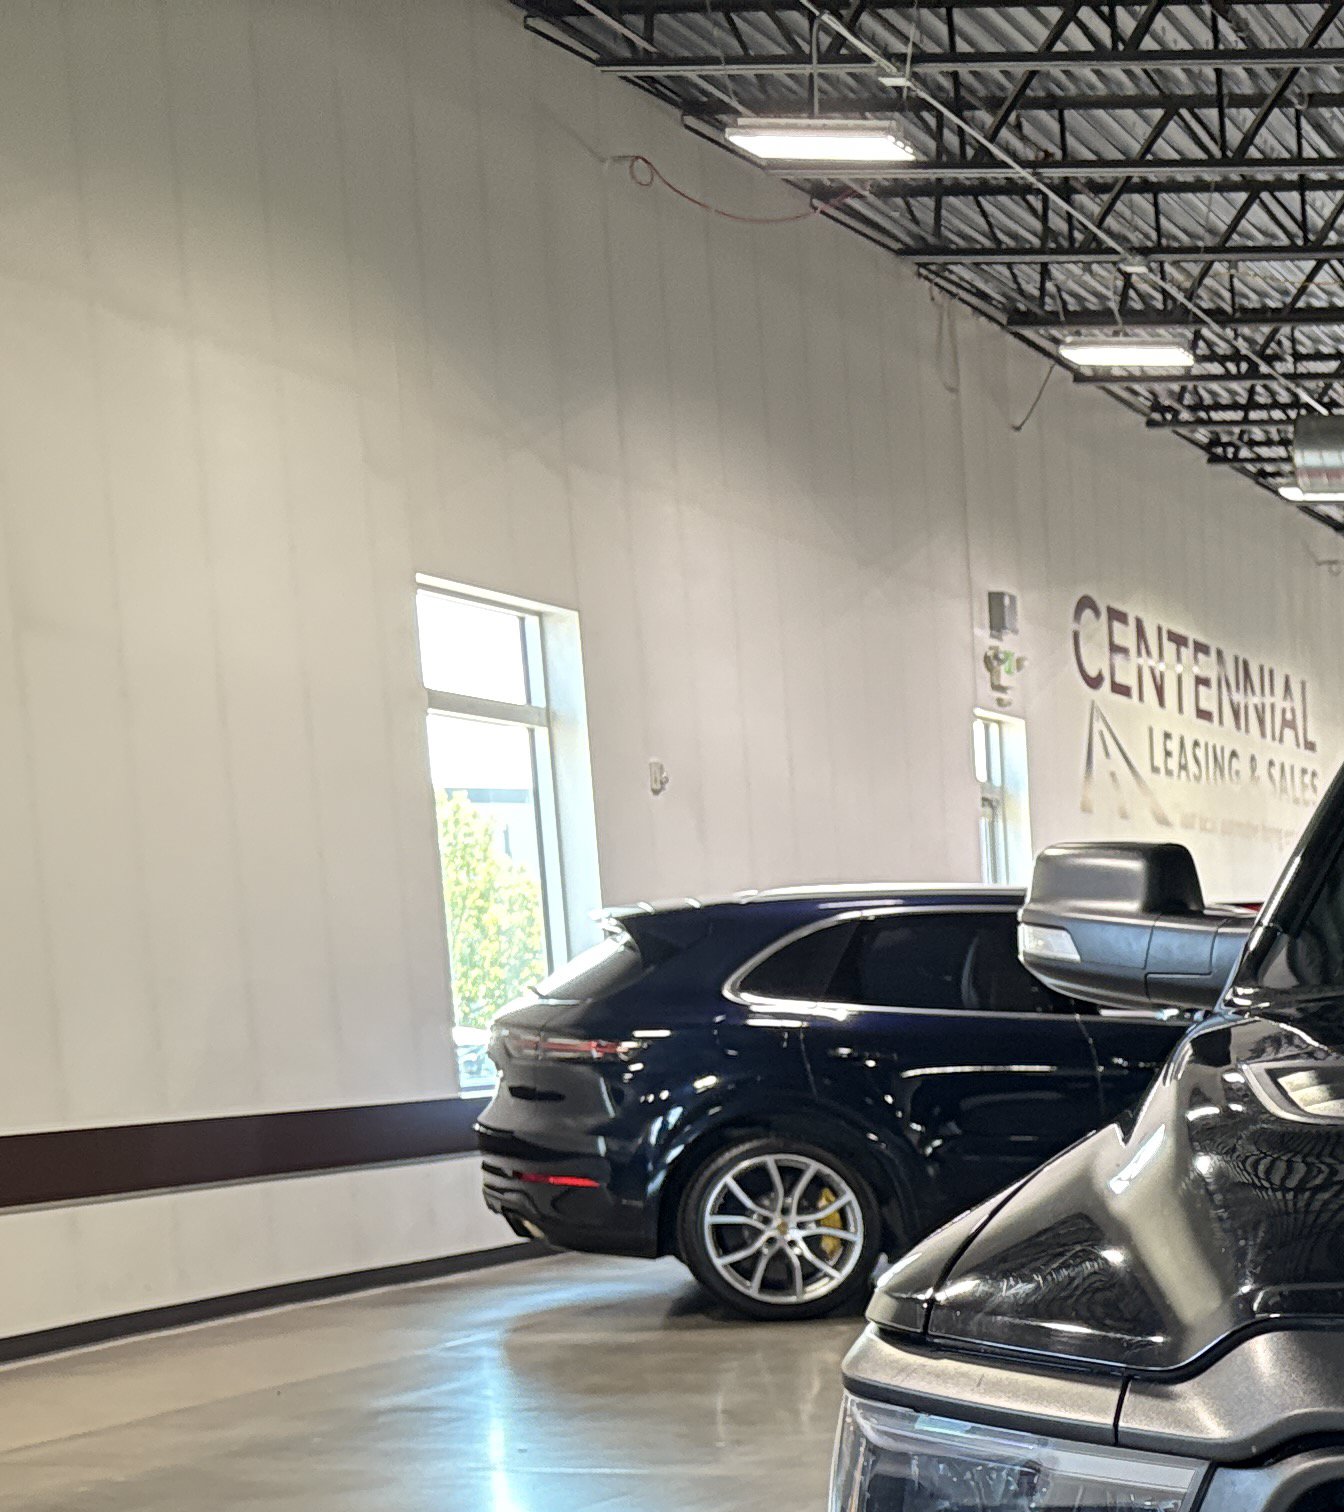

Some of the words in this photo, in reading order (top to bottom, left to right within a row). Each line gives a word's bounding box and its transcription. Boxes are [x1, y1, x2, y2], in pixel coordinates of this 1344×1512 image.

[1073, 594, 1317, 753] CENTENNIAL
[1149, 725, 1241, 786] LEASING
[1249, 753, 1261, 786] &
[1267, 757, 1319, 806] SALES
